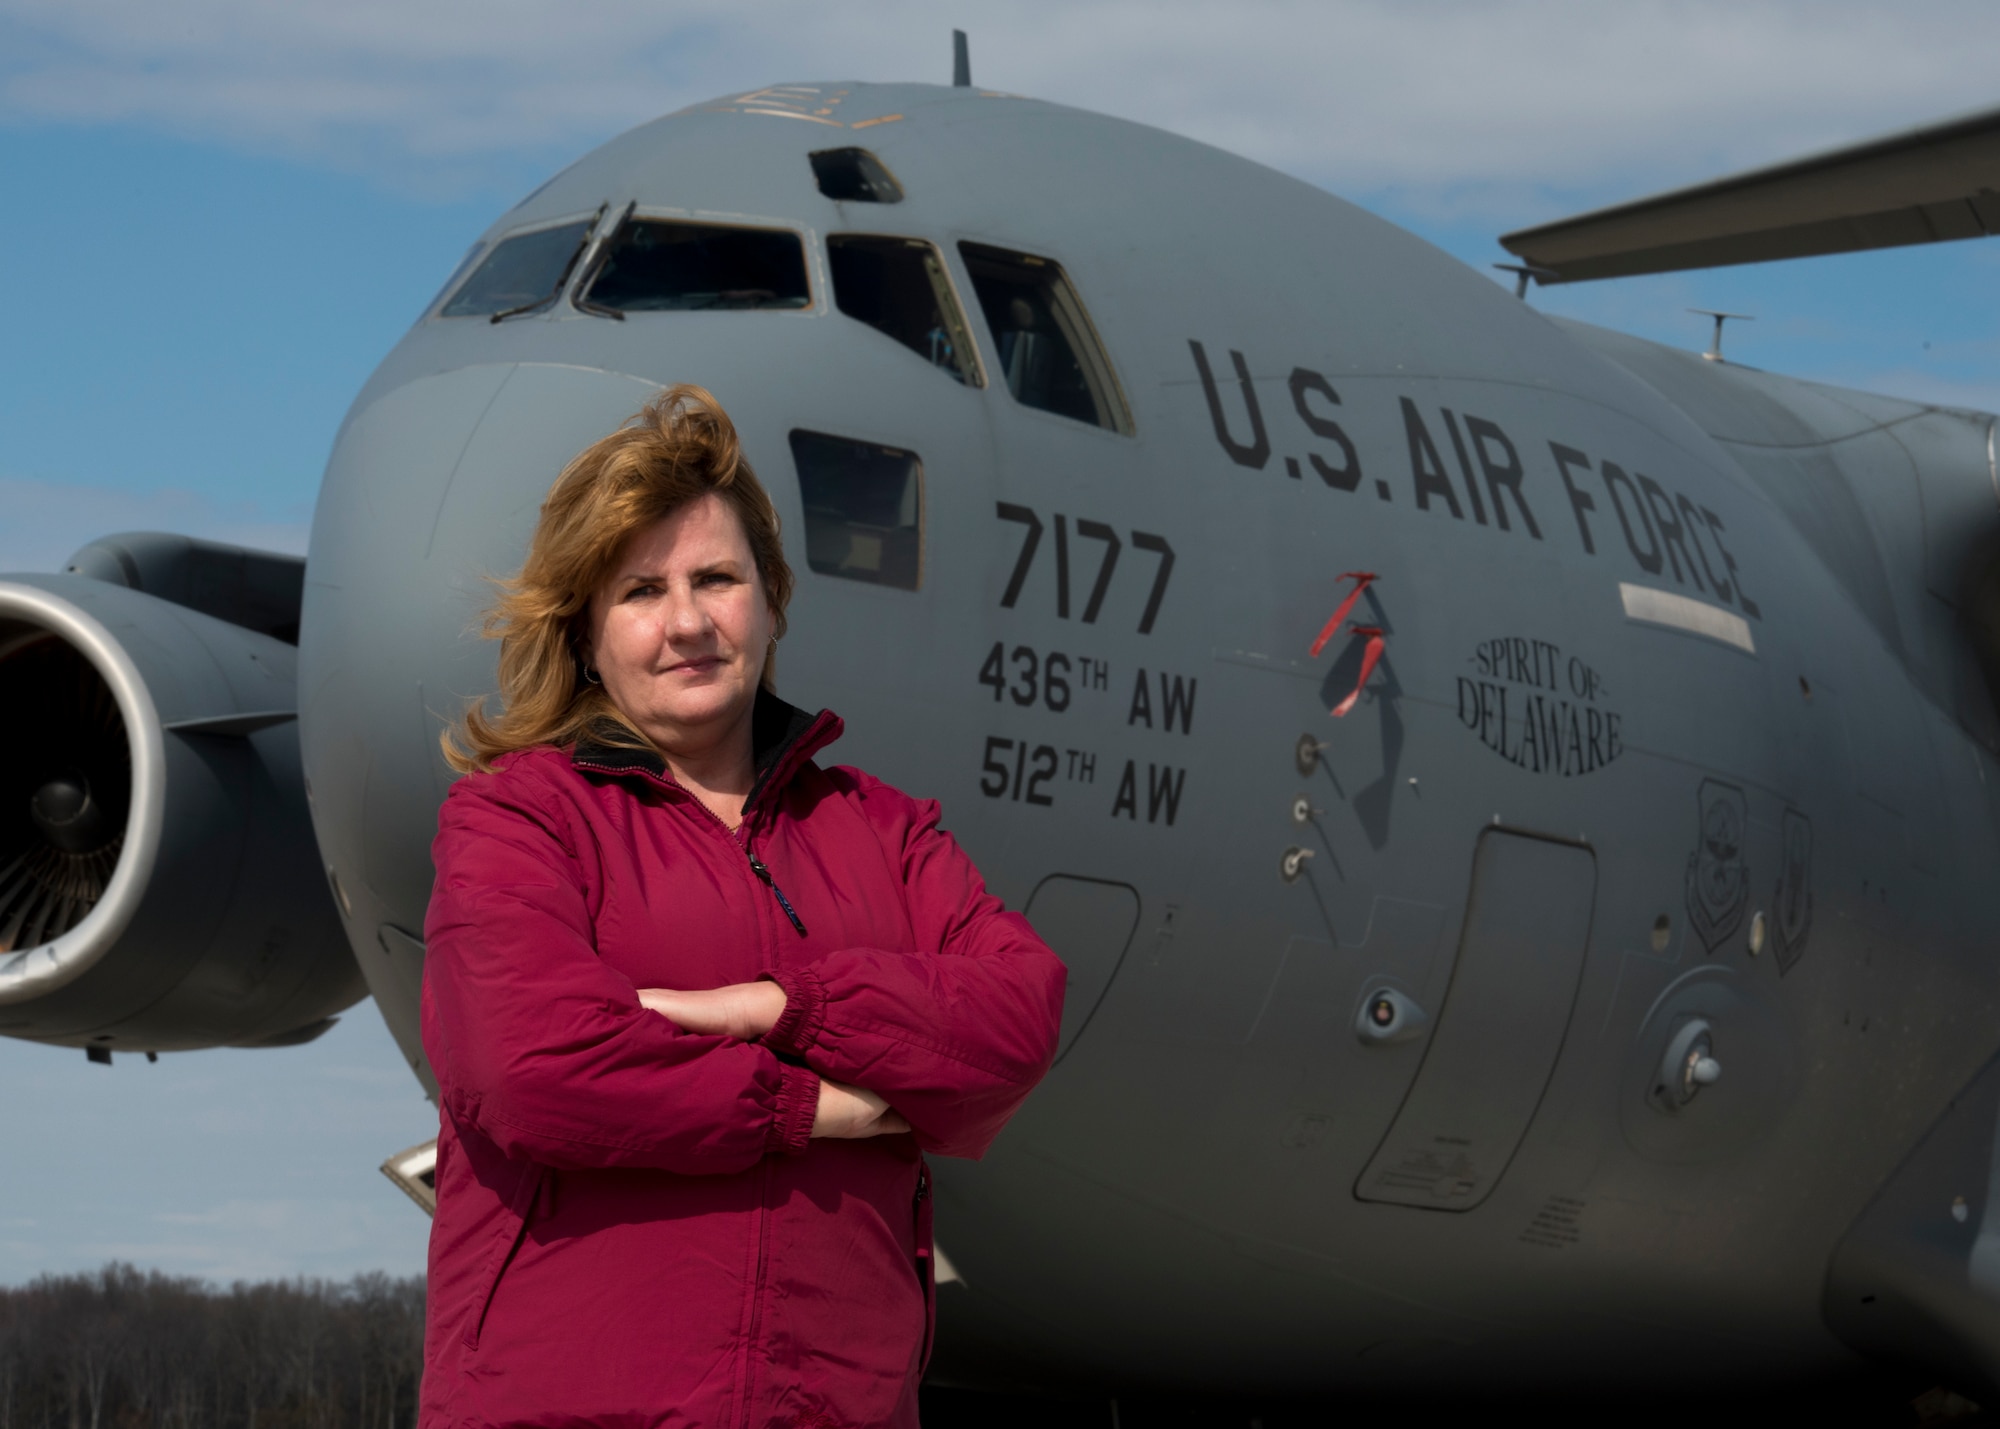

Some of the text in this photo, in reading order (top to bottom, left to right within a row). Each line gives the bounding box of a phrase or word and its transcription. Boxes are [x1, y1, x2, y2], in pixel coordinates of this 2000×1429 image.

[1189, 339, 1761, 622] U.S. AIR FORCE
[996, 501, 1176, 635] 7177
[1128, 668, 1197, 736] AW
[1456, 676, 1624, 777] DELAWARE
[1111, 759, 1186, 827] AW
